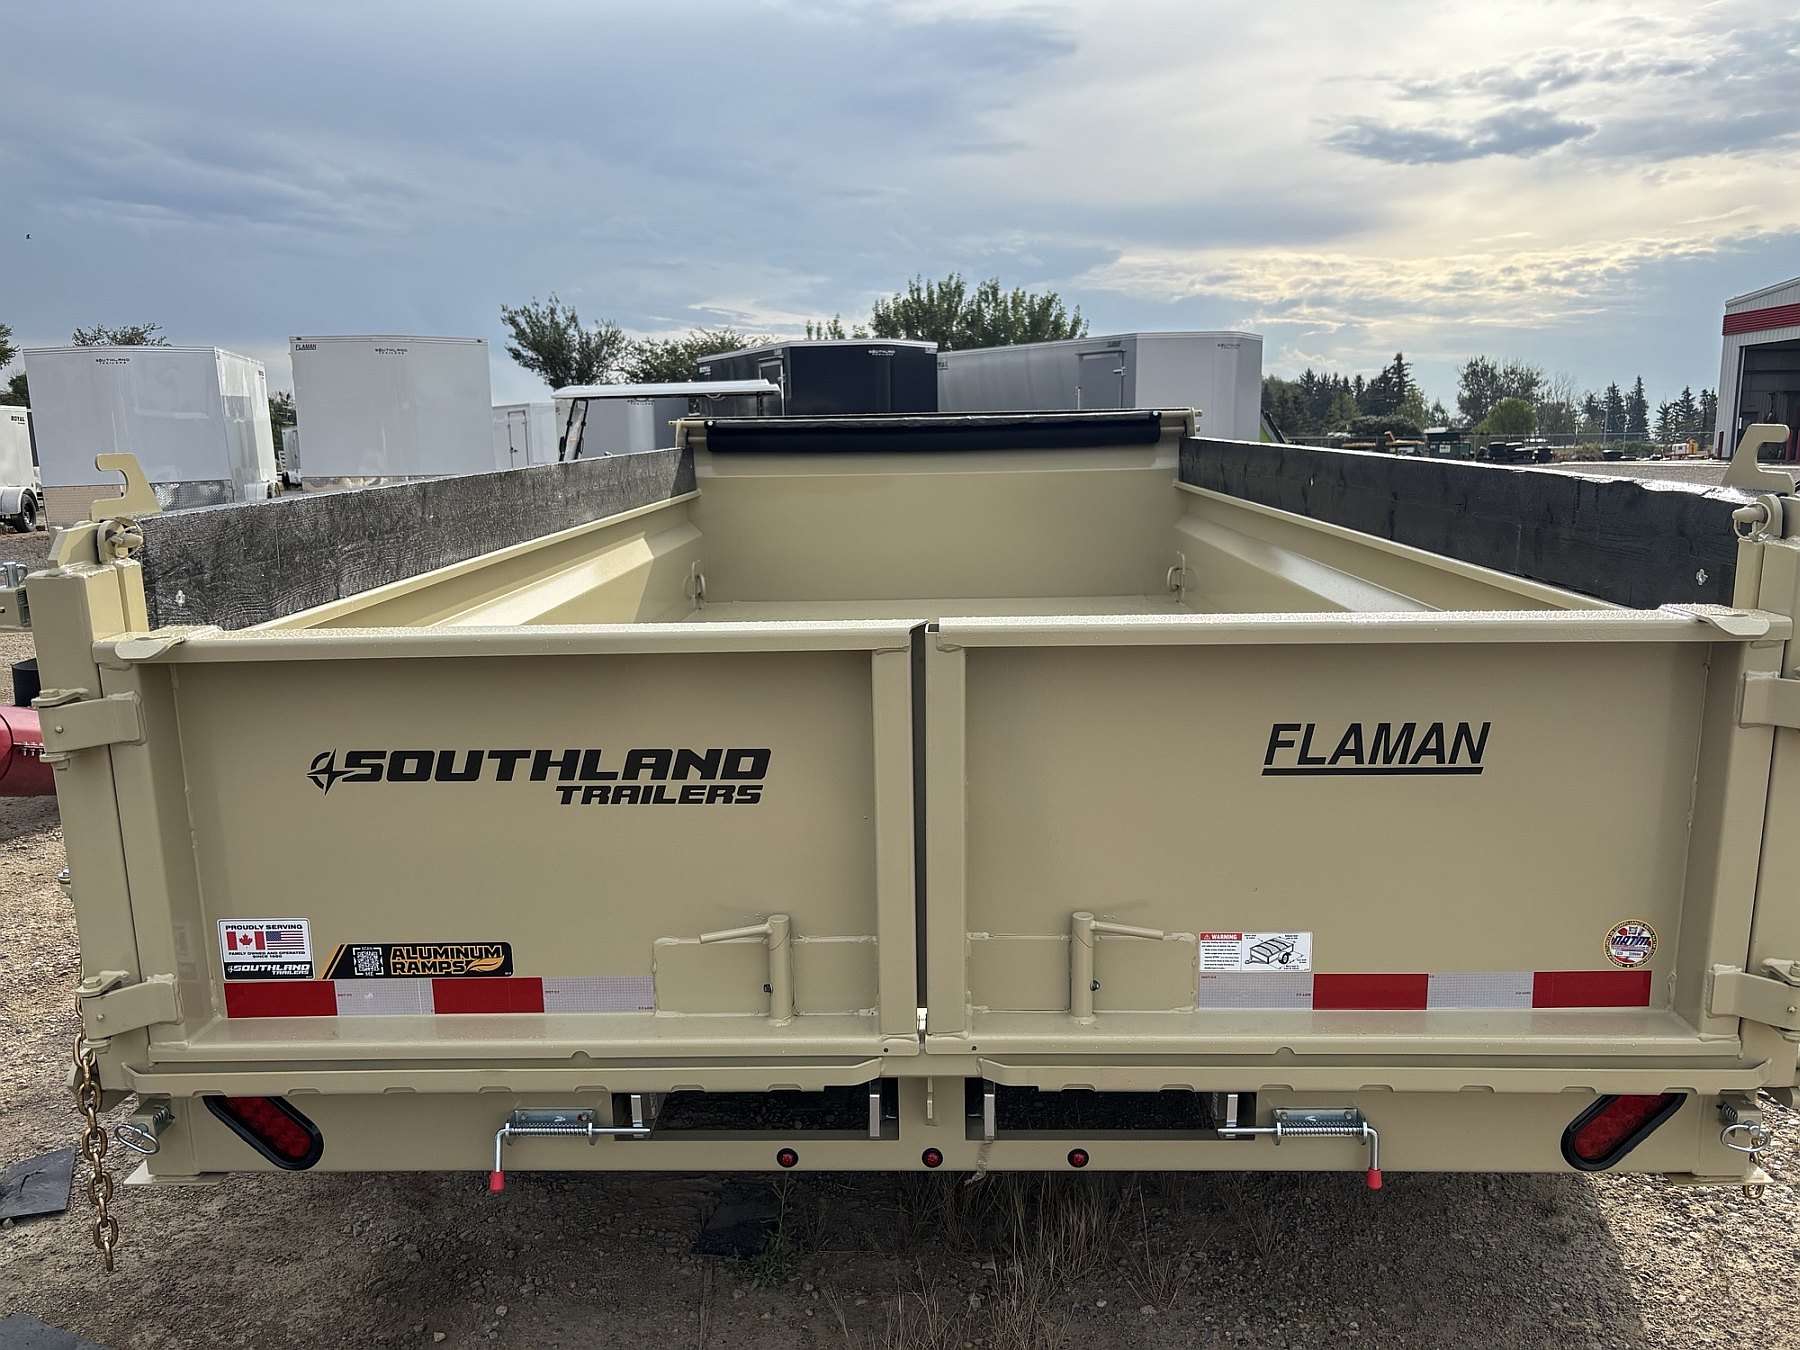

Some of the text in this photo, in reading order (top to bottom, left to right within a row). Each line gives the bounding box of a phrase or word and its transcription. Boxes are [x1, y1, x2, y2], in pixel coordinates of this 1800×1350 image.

[1263, 721, 1491, 766] FLAMAN
[340, 748, 771, 782] SOUTHLAND
[555, 784, 764, 805] TRAILERS
[391, 945, 503, 960] ALUMINUM
[232, 964, 310, 972] SOUTHLAND
[390, 960, 466, 975] RAMPS
